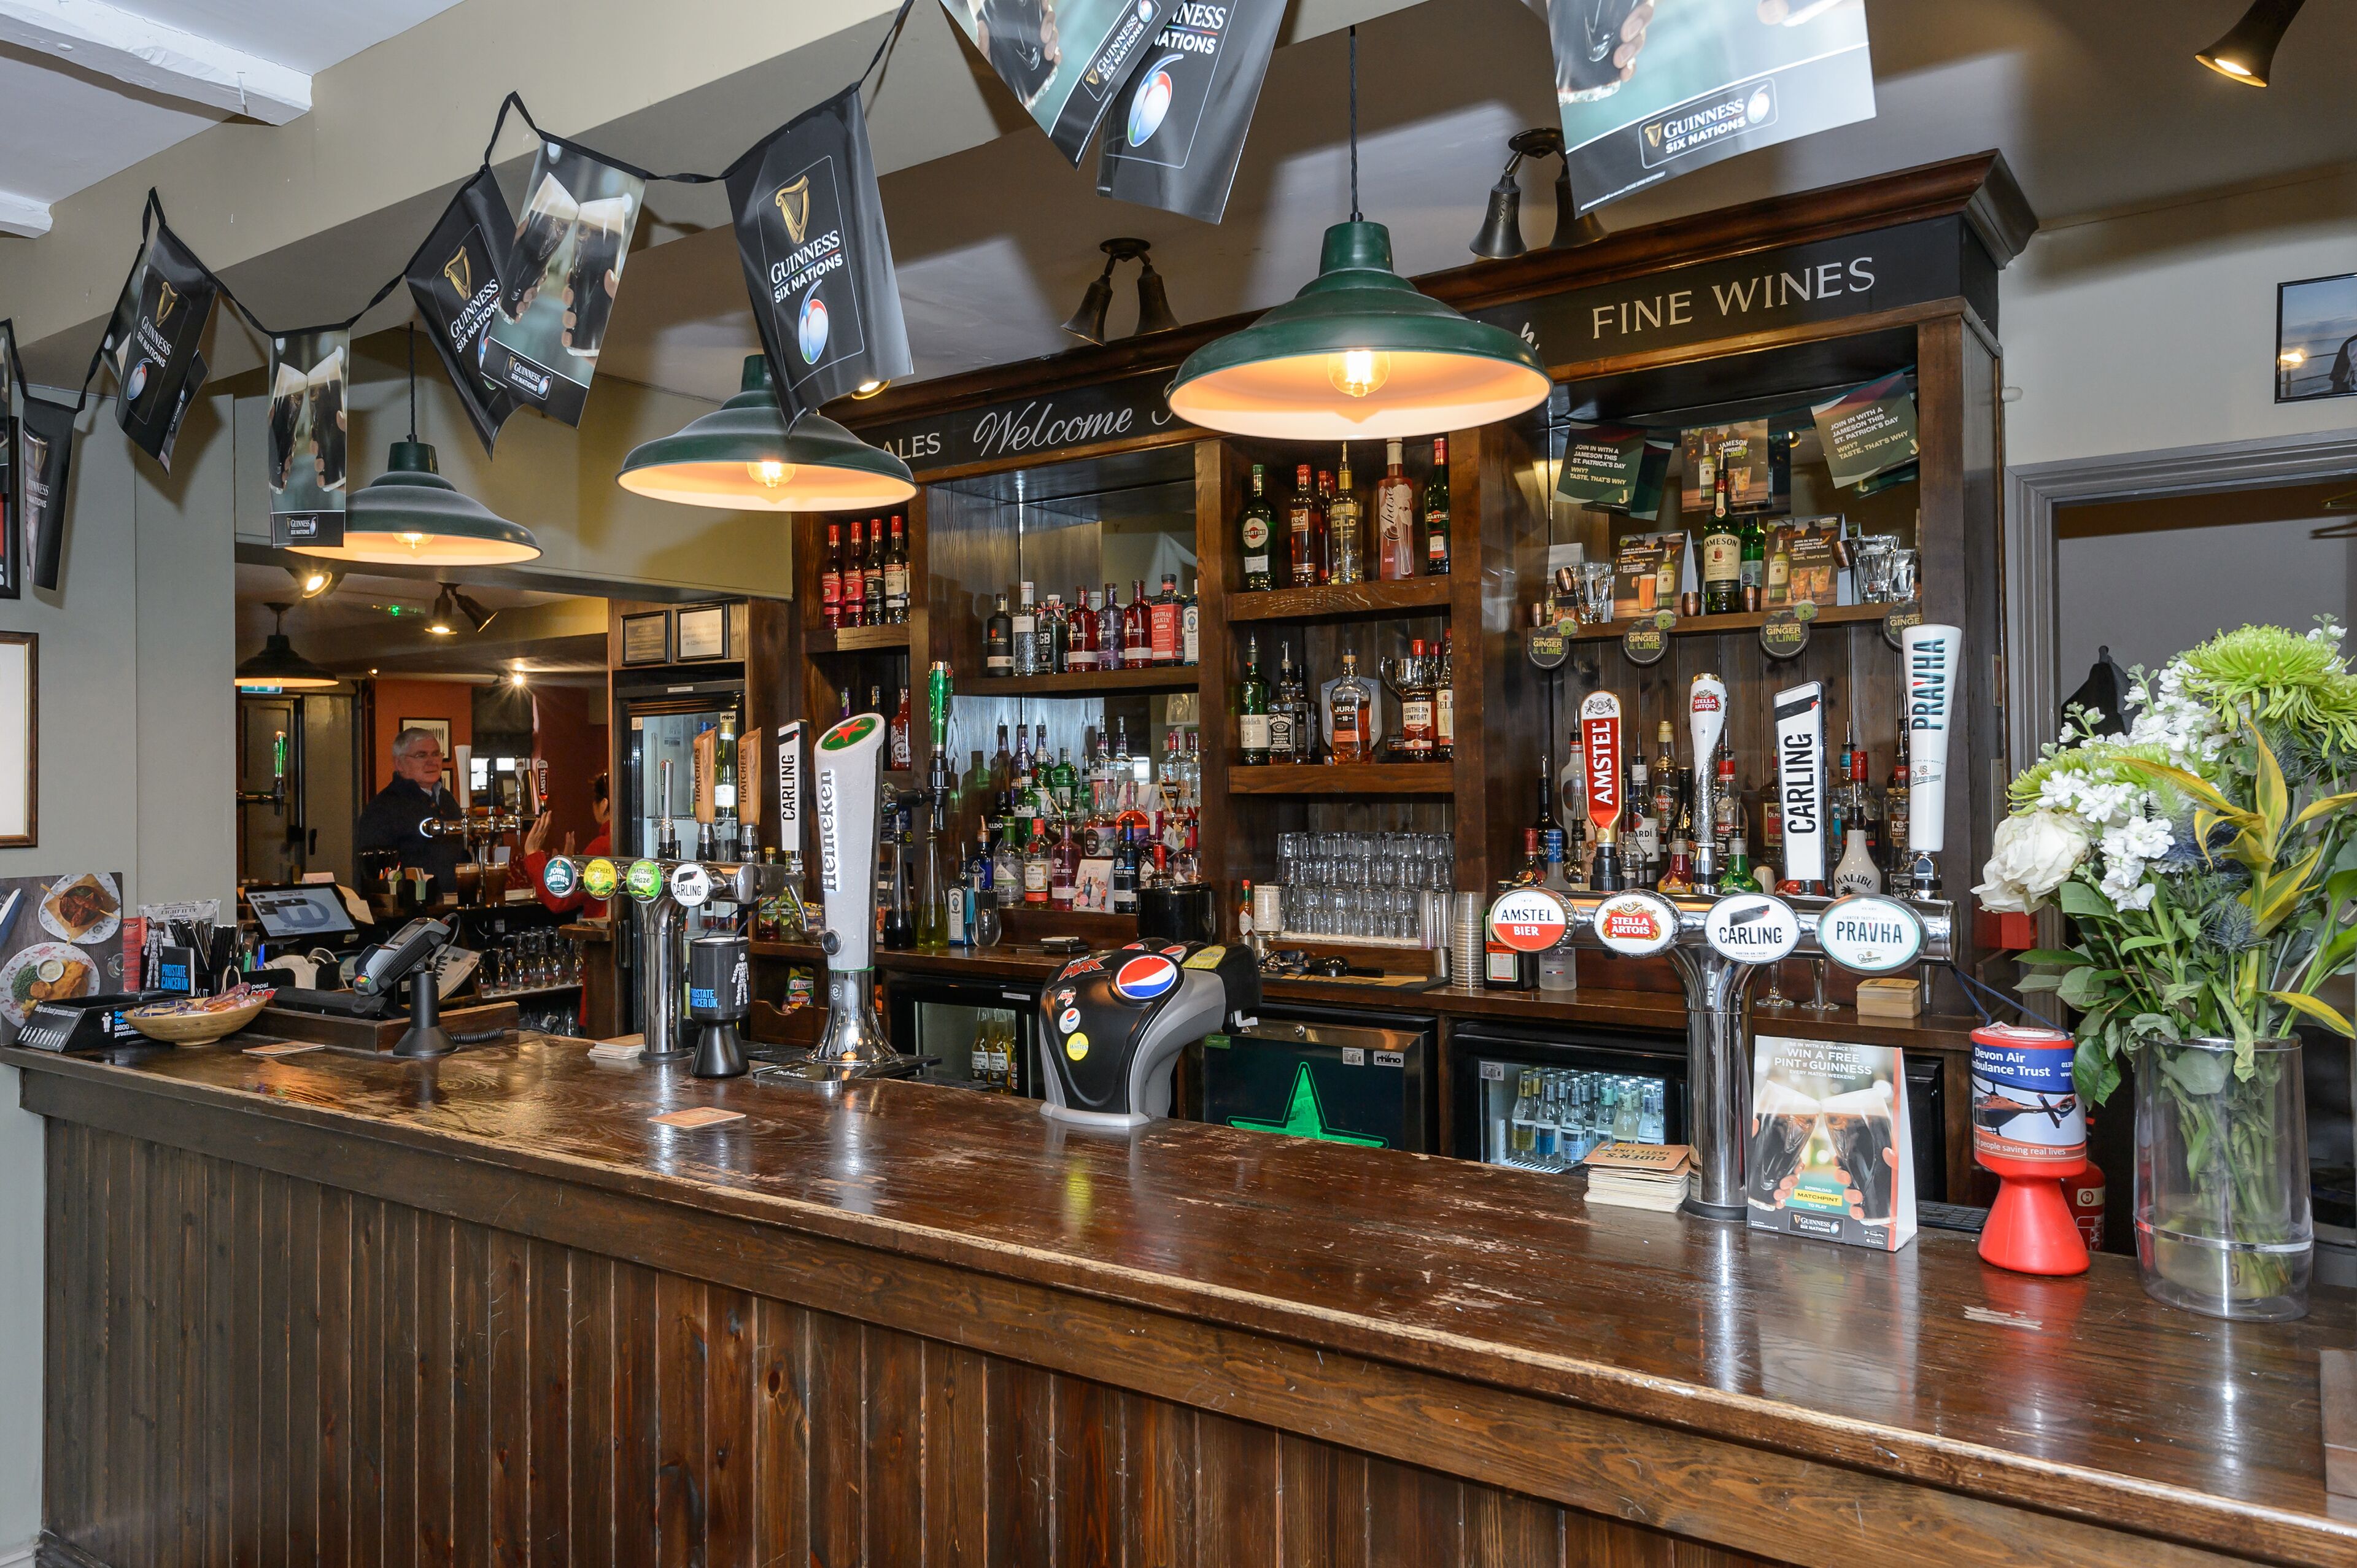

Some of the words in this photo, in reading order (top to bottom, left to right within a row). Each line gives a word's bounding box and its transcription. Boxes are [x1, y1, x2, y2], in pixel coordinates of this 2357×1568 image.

[1096, 13, 1139, 74] GUINNESS
[1103, 62, 1116, 81] SIX
[1115, 22, 1144, 66] NATIONS
[1663, 98, 1744, 140] GUINNESS
[1665, 137, 1687, 155] SIX
[1688, 115, 1746, 146] NATIONS
[770, 230, 840, 284] GUINNESS
[774, 286, 791, 303] SIX
[791, 253, 843, 291] NATIONS
[1592, 290, 1693, 339] FINE
[1711, 257, 1876, 316] WINES
[450, 279, 499, 338] GUINNESS
[456, 333, 470, 353] SIX
[467, 297, 500, 338] NATION
[141, 315, 172, 357] GUINNESS
[142, 339, 166, 368] NATIONS
[514, 361, 541, 383] GUINNESS
[519, 378, 538, 392] NATIONS
[1830, 419, 1846, 431] JOIN
[1856, 409, 1876, 421] WITH
[1832, 421, 1867, 438] JAMESON
[1867, 414, 1885, 425] THIS
[1846, 422, 1884, 441] PATRICK'S
[1884, 416, 1899, 427] DAY
[972, 401, 1133, 457] Welcome
[1836, 441, 1858, 453] WHY?
[1838, 447, 1864, 460] TASTE,
[1864, 438, 1889, 450] THAT'S
[1891, 430, 1909, 441] WHY
[1582, 459, 1612, 468] PATRICK'S
[1291, 513, 1304, 522] red
[1381, 486, 1401, 541] Chase
[290, 519, 310, 528] GUINNESS
[1704, 538, 1738, 550] JAMESON
[1776, 634, 1801, 643] LIME
[1911, 638, 1946, 732] PRAVHA
[1269, 716, 1277, 725] JACK
[1592, 721, 1613, 805] AMSTEL
[781, 754, 795, 822] CARLING
[1784, 732, 1816, 835] CARLING
[821, 770, 837, 892] Heineken
[587, 866, 611, 875] THATCHERS
[546, 875, 570, 886] SMITH'S
[1835, 873, 1875, 889] MALIBU
[673, 883, 702, 896] CARLING
[1501, 908, 1554, 922] AMSTEL
[1611, 917, 1649, 926] STELLA
[1513, 925, 1540, 937] BIER
[1611, 925, 1651, 935] ARTOIS
[1719, 926, 1782, 944] CARLING
[1836, 921, 1903, 944] PRAVHA
[1058, 956, 1111, 982] MAX
[1068, 954, 1091, 967] pepsi
[162, 964, 187, 978] PROSTATE
[161, 976, 182, 989] CANCER
[182, 977, 189, 991] UK
[708, 998, 718, 1008] UK
[1377, 1054, 1402, 1065] rhino
[1787, 1048, 1811, 1058] WIN
[1815, 1051, 1824, 1060] A
[1828, 1051, 1860, 1063] FREE
[1975, 1047, 2003, 1061] Devon
[2006, 1051, 2026, 1064] Air
[1775, 1057, 1802, 1068] PINT
[1809, 1060, 1872, 1075] GUINNESS
[1972, 1060, 2014, 1076] mbulance
[2016, 1065, 2051, 1078] Trust
[1980, 1141, 2000, 1152] people
[2002, 1145, 2028, 1156] saving
[2030, 1146, 2048, 1156] real
[2048, 1147, 2066, 1156] lives
[1606, 1153, 1667, 1162] CIDER'S
[1797, 1192, 1839, 1203] MATCHPINT
[1805, 1185, 1832, 1194] DOWNLOAD
[1800, 1218, 1830, 1227] GUINNESS
[1809, 1225, 1830, 1234] NATIONS
